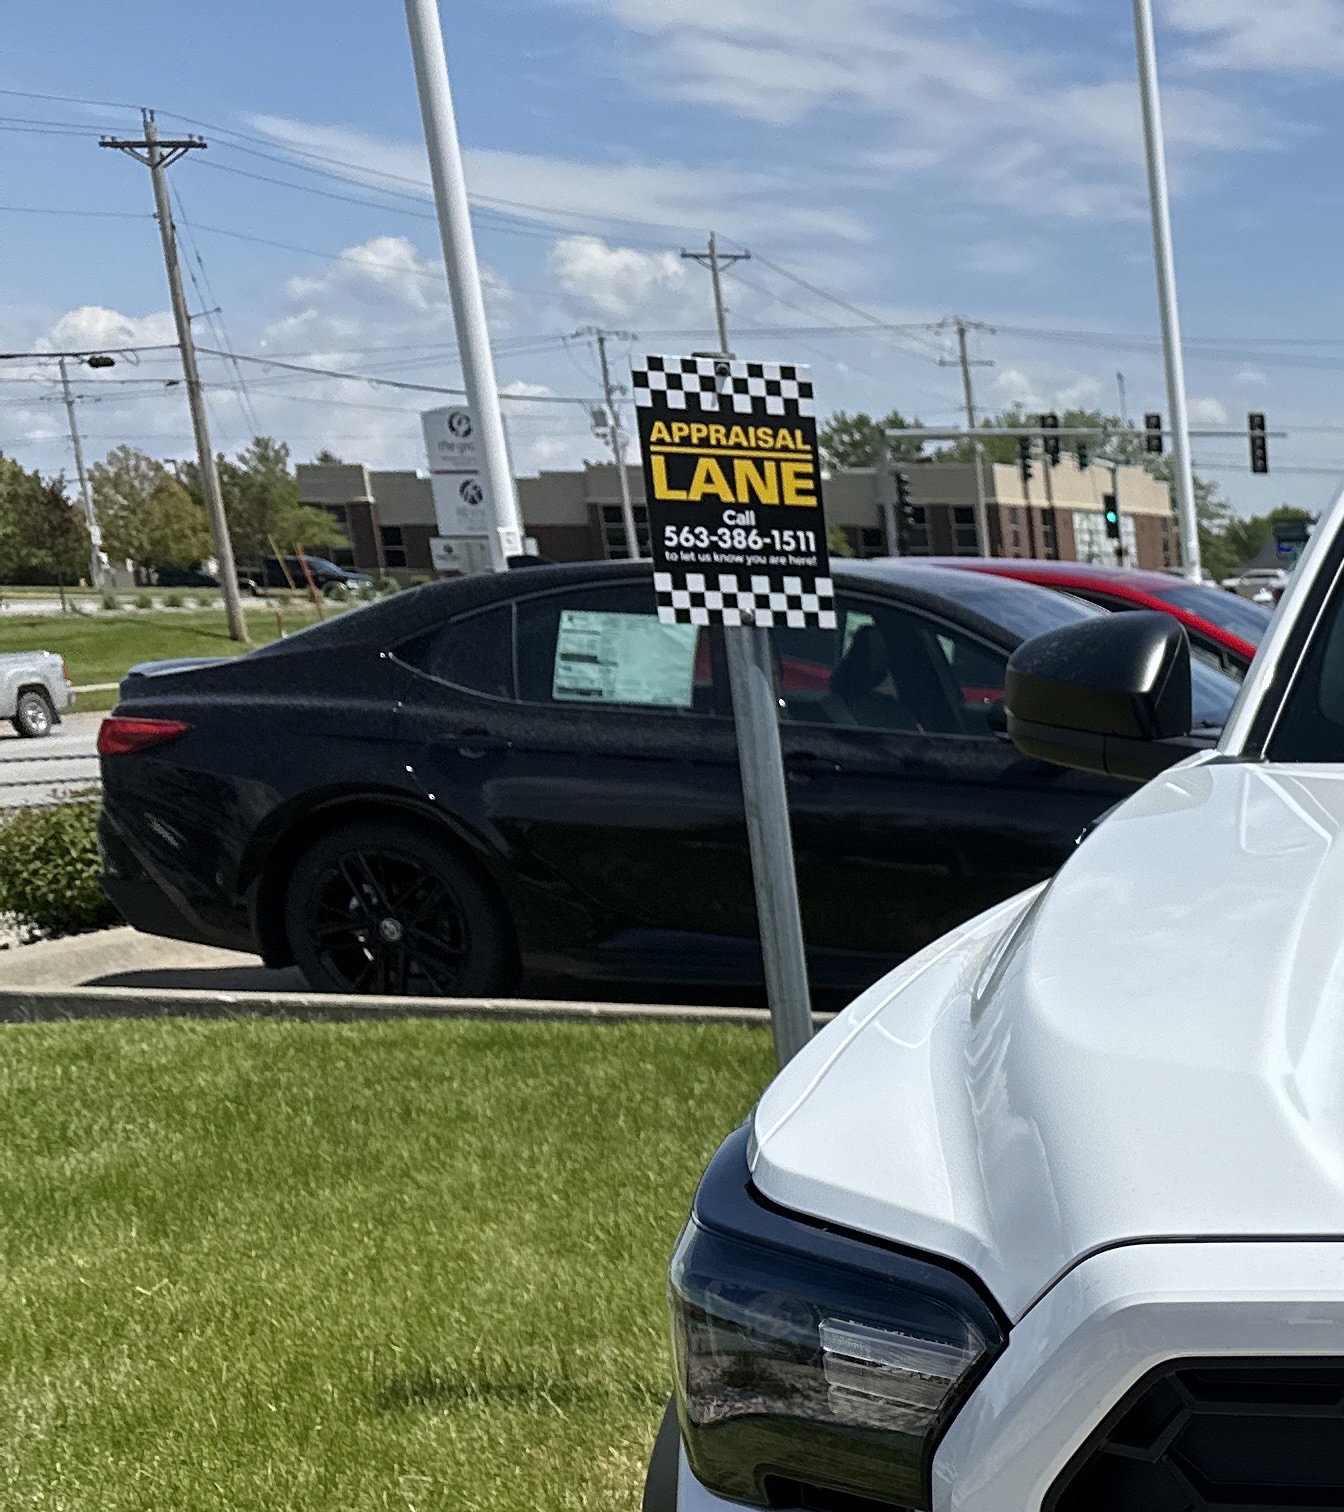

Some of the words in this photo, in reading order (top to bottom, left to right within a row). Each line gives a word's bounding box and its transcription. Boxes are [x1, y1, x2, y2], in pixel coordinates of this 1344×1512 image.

[650, 421, 811, 451] APPRAISAL
[651, 455, 817, 507] LANE
[722, 509, 756, 527] Call
[664, 525, 816, 553] 563-386-1511
[664, 550, 679, 562] to
[680, 550, 696, 562] let
[698, 552, 712, 562] us
[713, 551, 744, 564] know
[746, 554, 767, 567] you
[769, 555, 788, 566] are
[788, 553, 818, 567] here!
